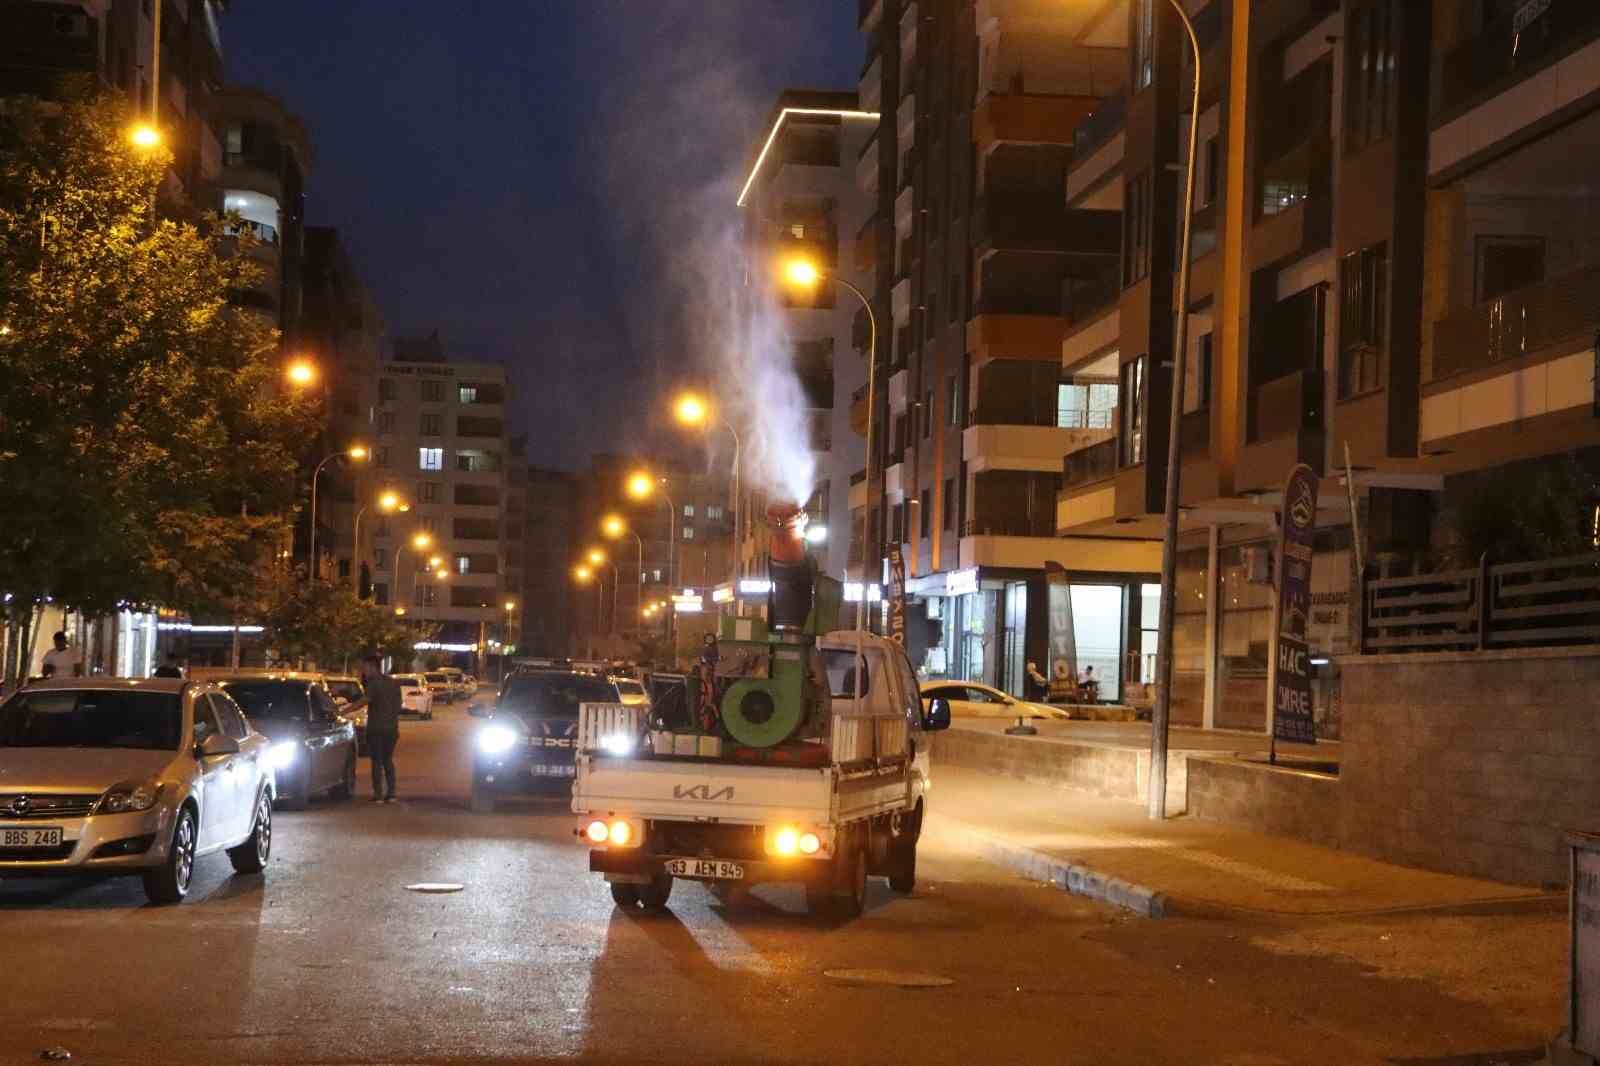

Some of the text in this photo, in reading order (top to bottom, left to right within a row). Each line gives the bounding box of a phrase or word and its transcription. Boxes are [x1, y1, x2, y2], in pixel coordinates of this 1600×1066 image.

[5, 831, 58, 844] BBS 248
[695, 861, 717, 875] AEM
[720, 863, 744, 879] 945
